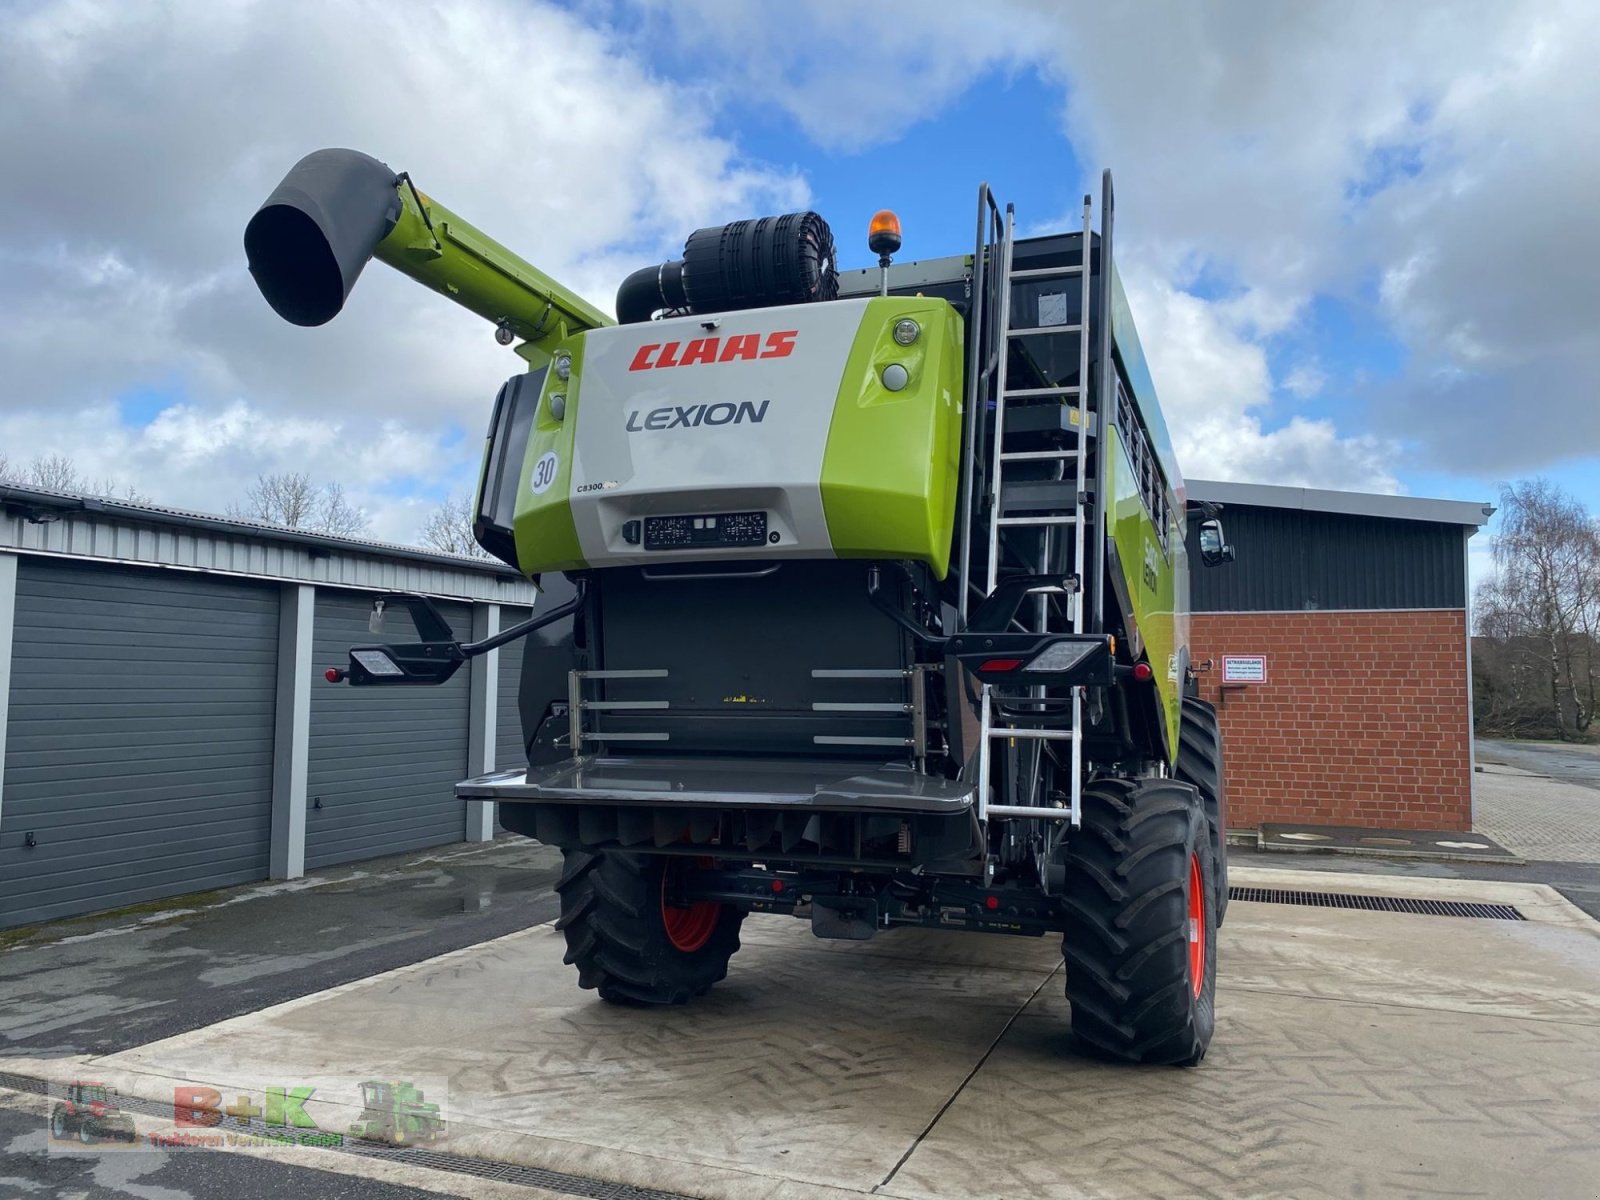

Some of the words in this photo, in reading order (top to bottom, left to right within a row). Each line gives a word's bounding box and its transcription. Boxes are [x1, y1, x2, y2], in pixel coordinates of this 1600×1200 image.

[628, 330, 799, 372] CLAAS
[625, 399, 771, 432] LEXION
[533, 456, 556, 489] 30
